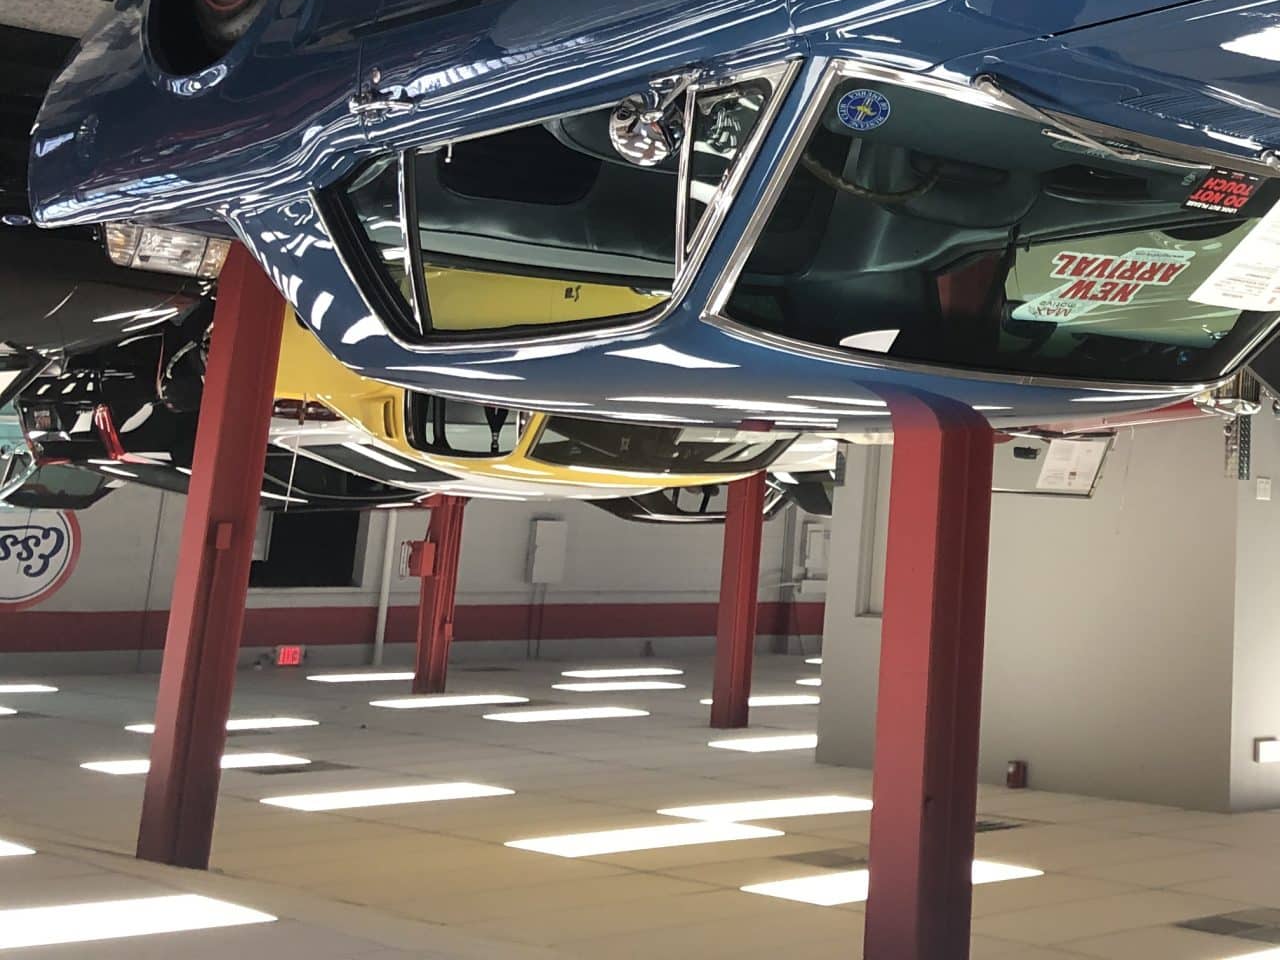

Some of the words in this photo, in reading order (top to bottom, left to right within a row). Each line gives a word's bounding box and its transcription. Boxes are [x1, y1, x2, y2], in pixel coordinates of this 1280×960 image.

[1202, 177, 1254, 196] TOUCH
[1190, 189, 1225, 204] NOT
[1223, 195, 1249, 208] DO
[1055, 253, 1185, 283] ARRIVAL
[1058, 279, 1141, 303] NEW
[1032, 306, 1072, 317] MAX
[0, 525, 64, 578] Ess
[277, 647, 300, 665] EXIT
